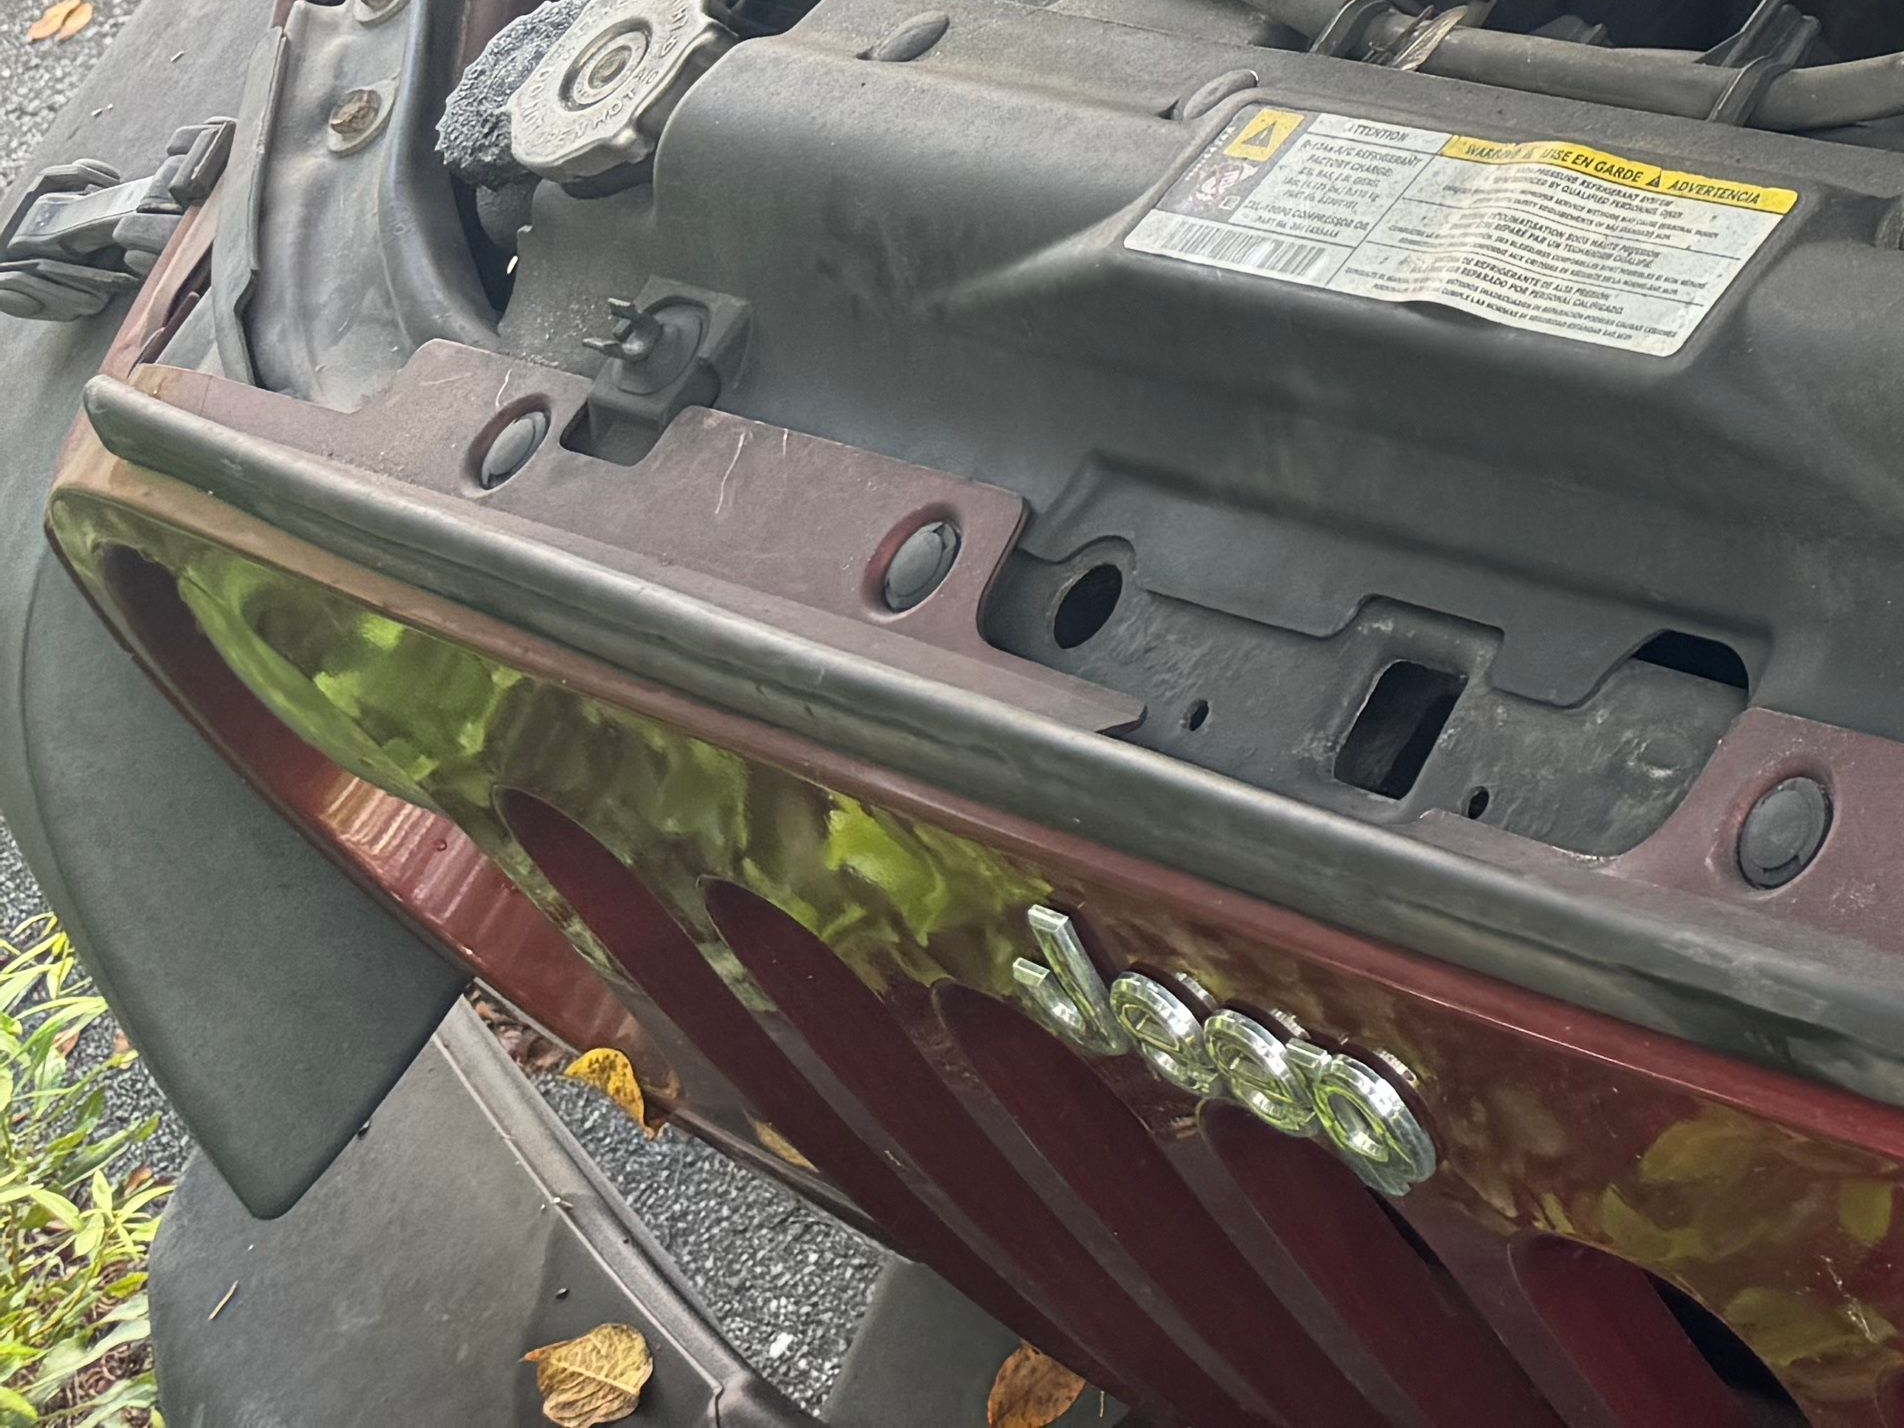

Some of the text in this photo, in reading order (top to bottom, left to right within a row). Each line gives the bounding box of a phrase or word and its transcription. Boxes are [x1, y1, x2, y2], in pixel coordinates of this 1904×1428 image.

[1547, 181, 1562, 194] BY
[1571, 152, 1595, 168] EN
[1594, 157, 1645, 183] GARDE
[1666, 179, 1761, 204] ADVERTENCIA
[1528, 231, 1548, 245] PAR
[1458, 267, 1509, 289] REPARADO
[1508, 281, 1530, 295] POR
